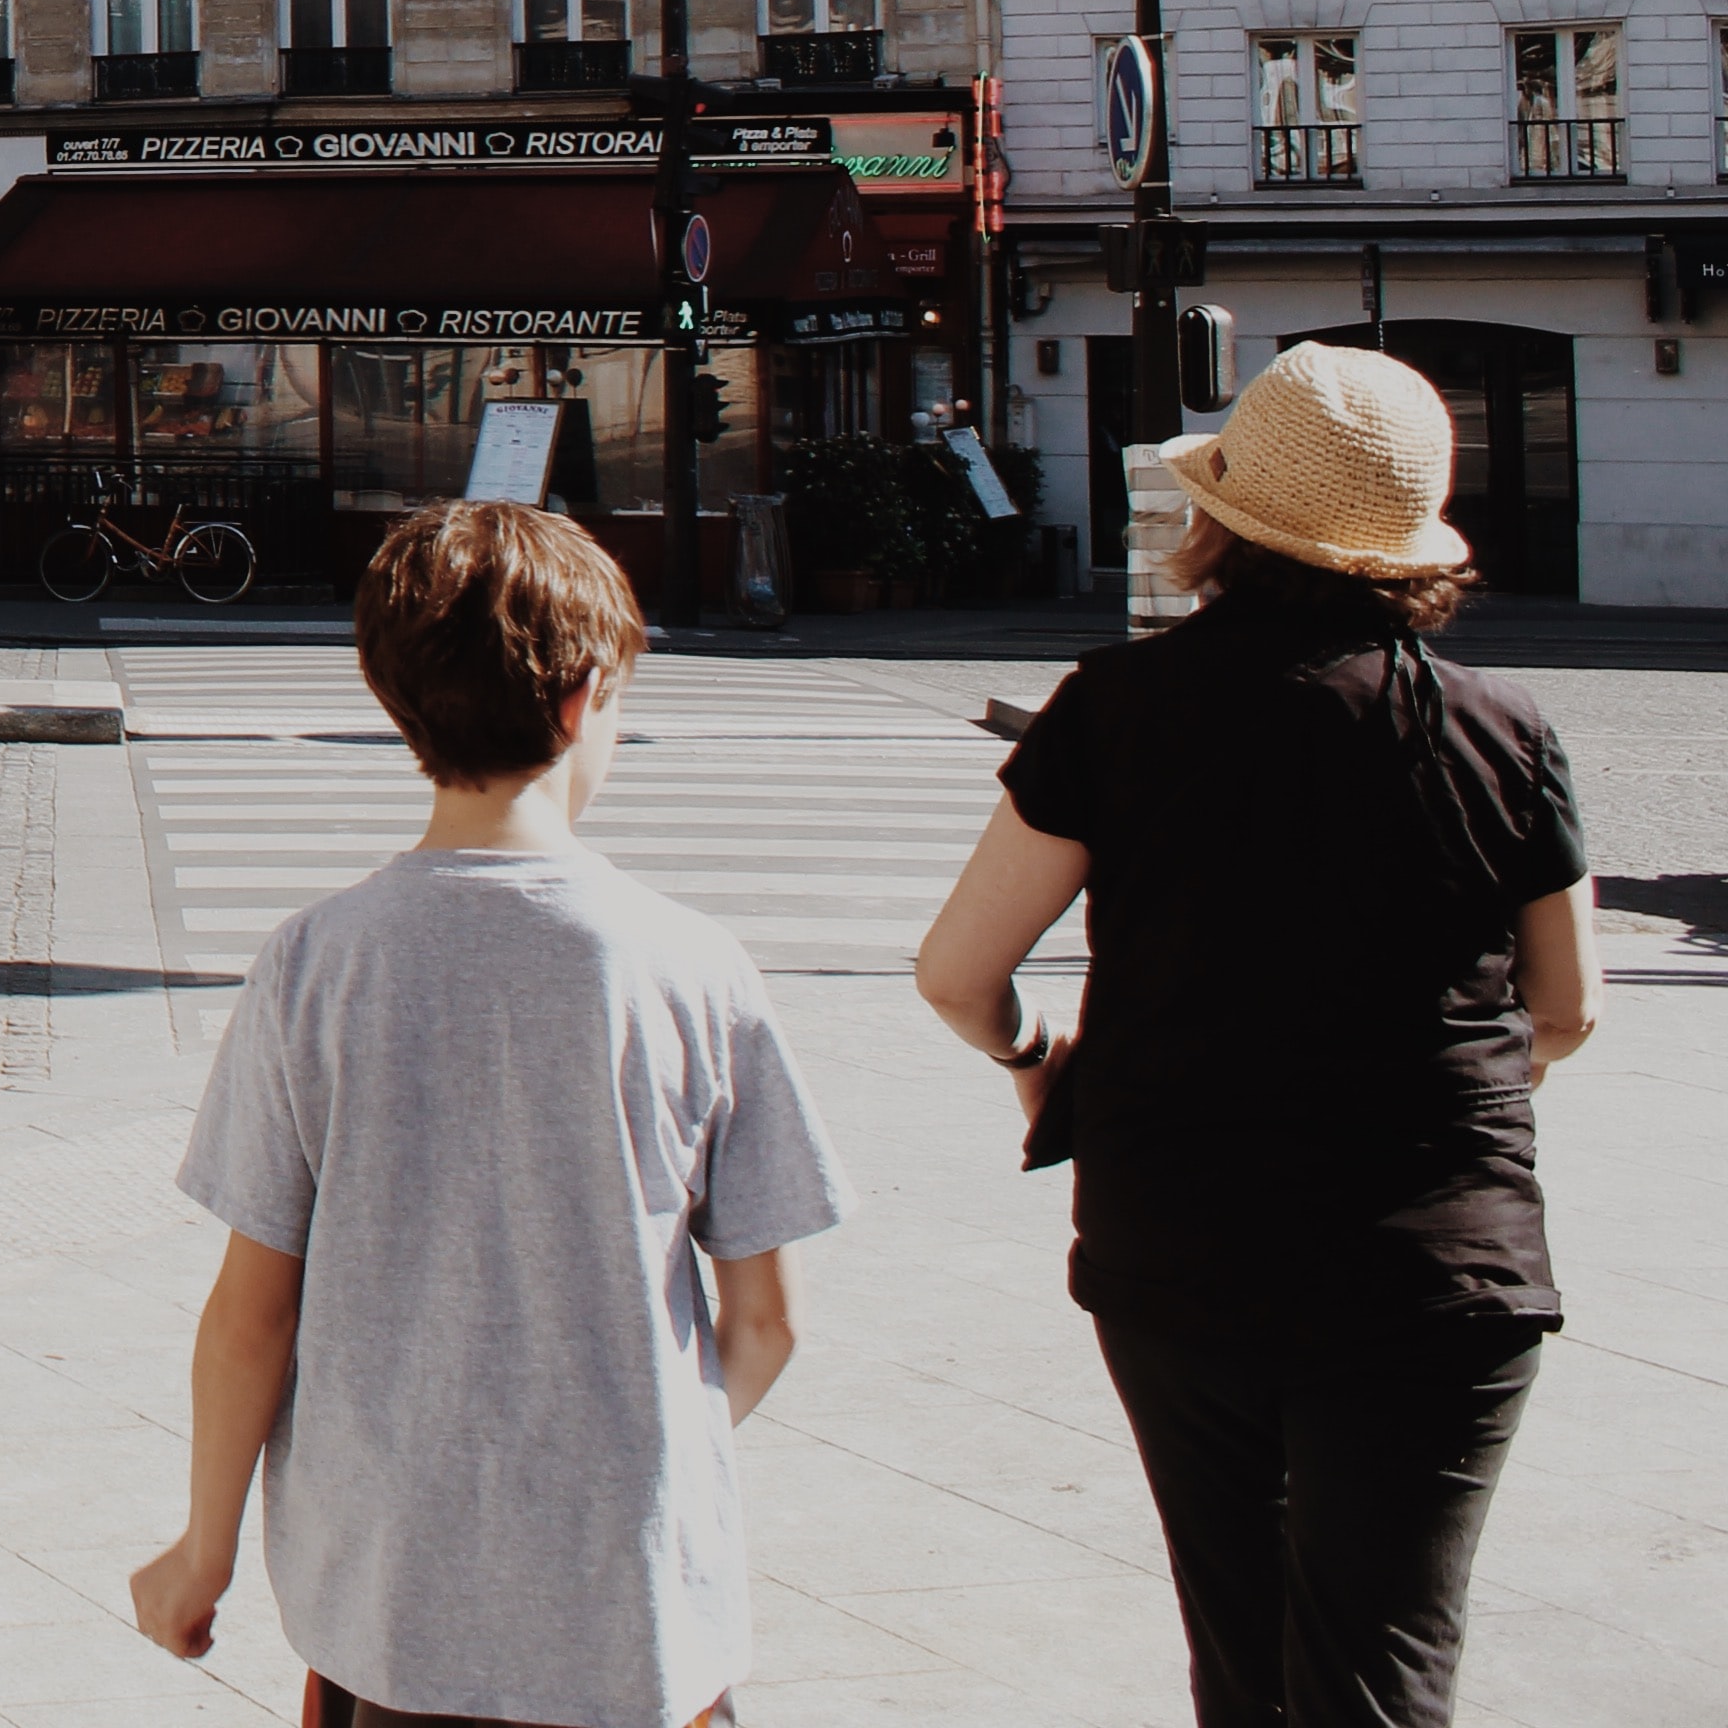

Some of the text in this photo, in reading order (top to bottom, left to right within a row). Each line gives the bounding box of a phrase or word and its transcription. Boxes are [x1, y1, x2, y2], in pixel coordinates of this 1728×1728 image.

[732, 126, 818, 139] Pizza & Plats
[63, 137, 120, 151] ouvert 7/7
[141, 131, 663, 160] PIZZERIA GIOVANNI RISTORA
[751, 140, 812, 153] emporter
[831, 145, 954, 178] vanni
[908, 248, 936, 261] Grill
[37, 307, 747, 335] PIZZERIA GIOVANNI RISTORANTE Plats
[496, 405, 549, 414] GIOVANNI
